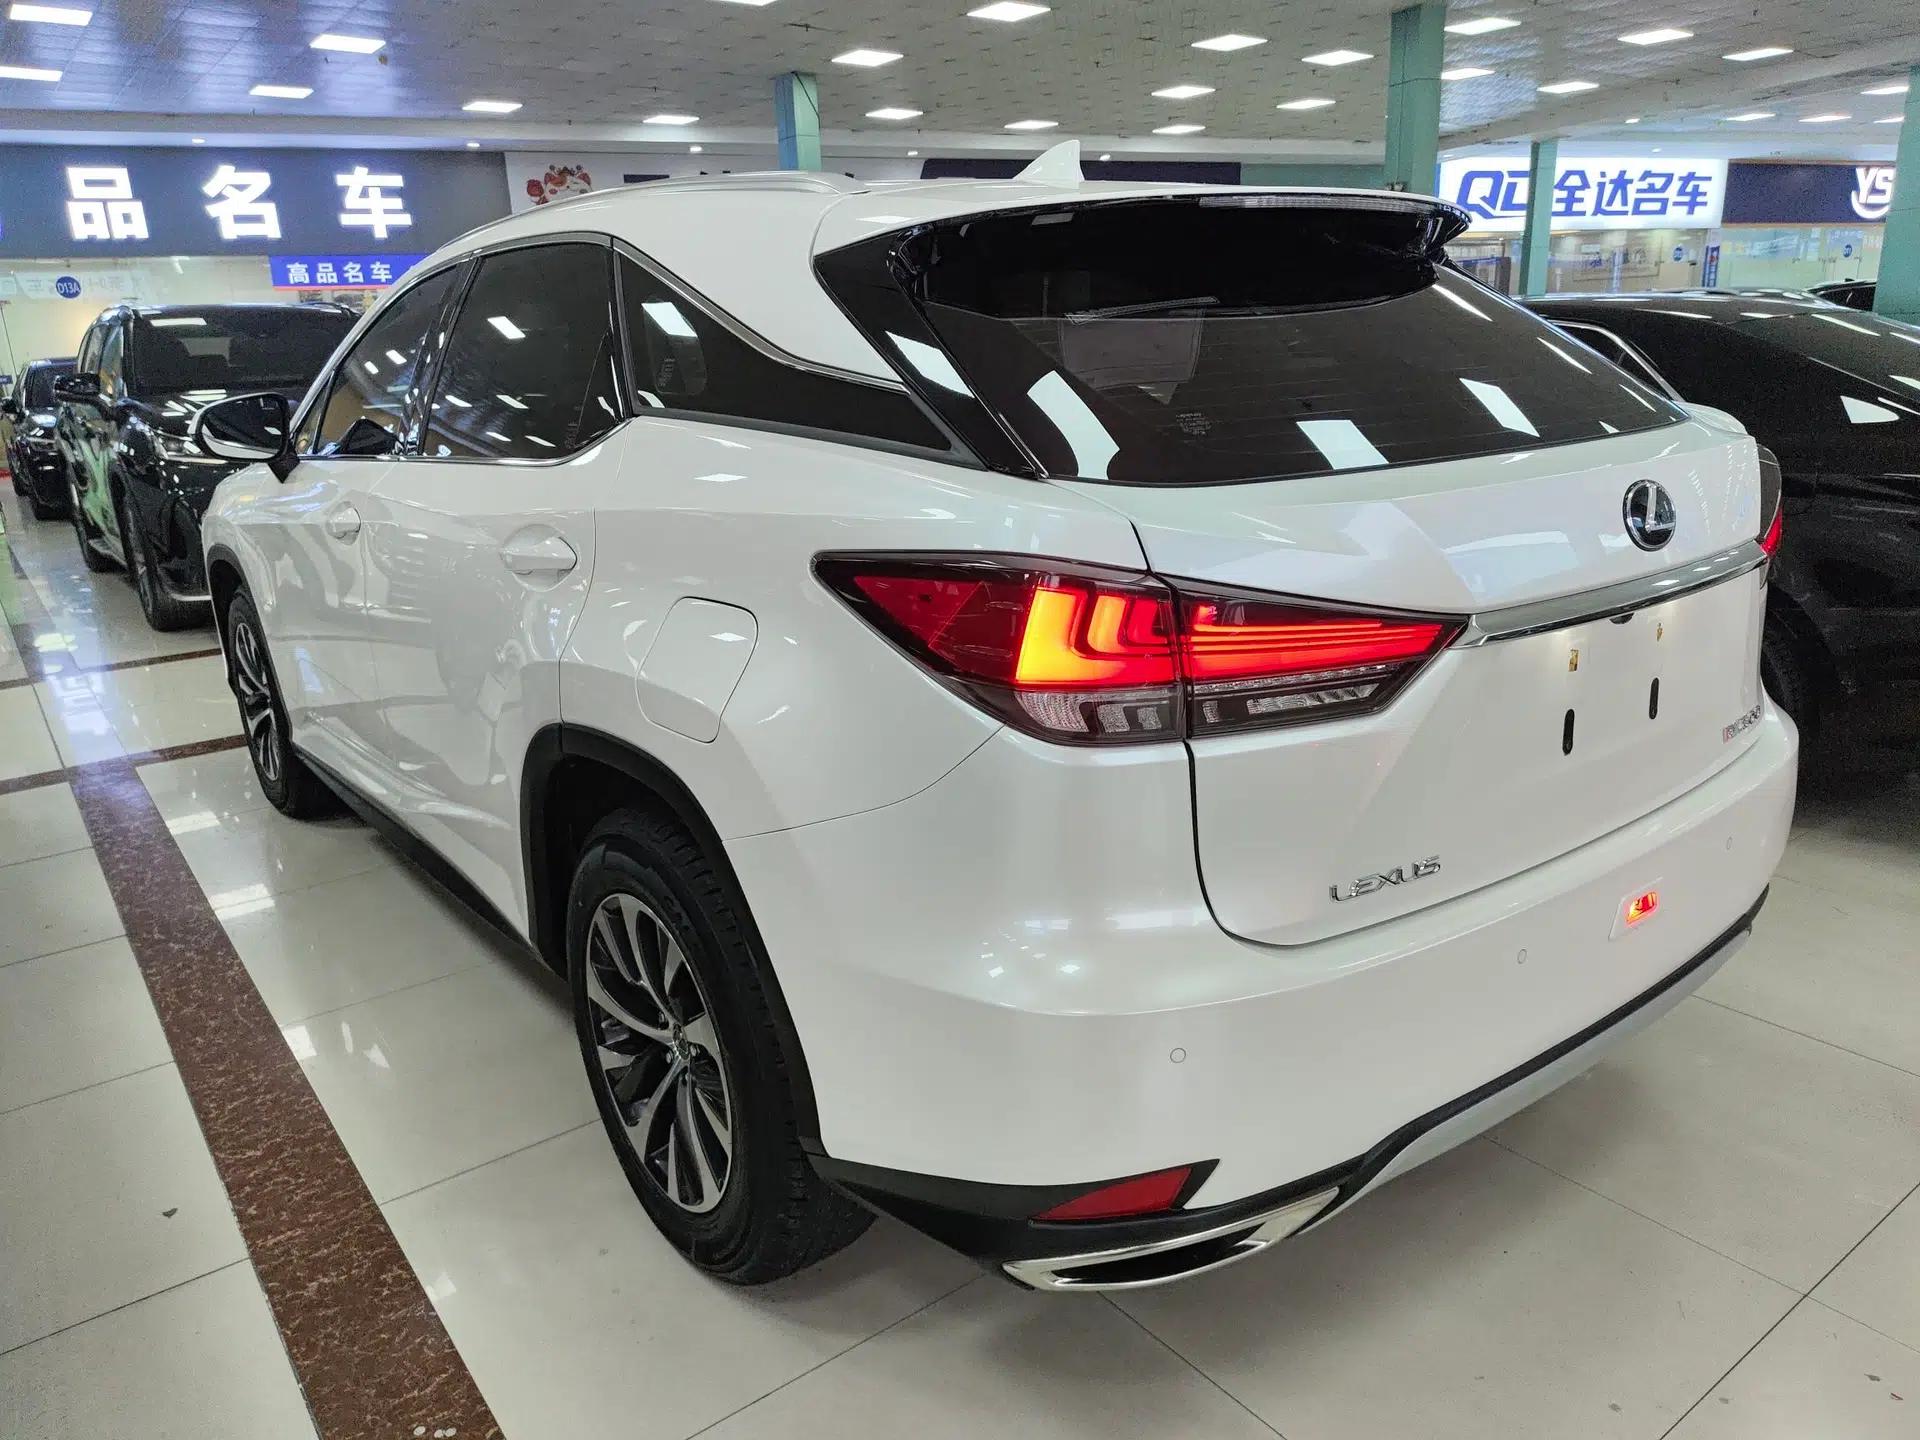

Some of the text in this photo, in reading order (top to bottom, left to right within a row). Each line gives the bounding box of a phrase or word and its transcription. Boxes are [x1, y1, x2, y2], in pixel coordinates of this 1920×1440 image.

[66, 165, 412, 240] 品名车
[1552, 169, 1713, 217] 全达名车
[286, 261, 393, 284] 高品名车
[1329, 855, 1441, 902] LEXUS
